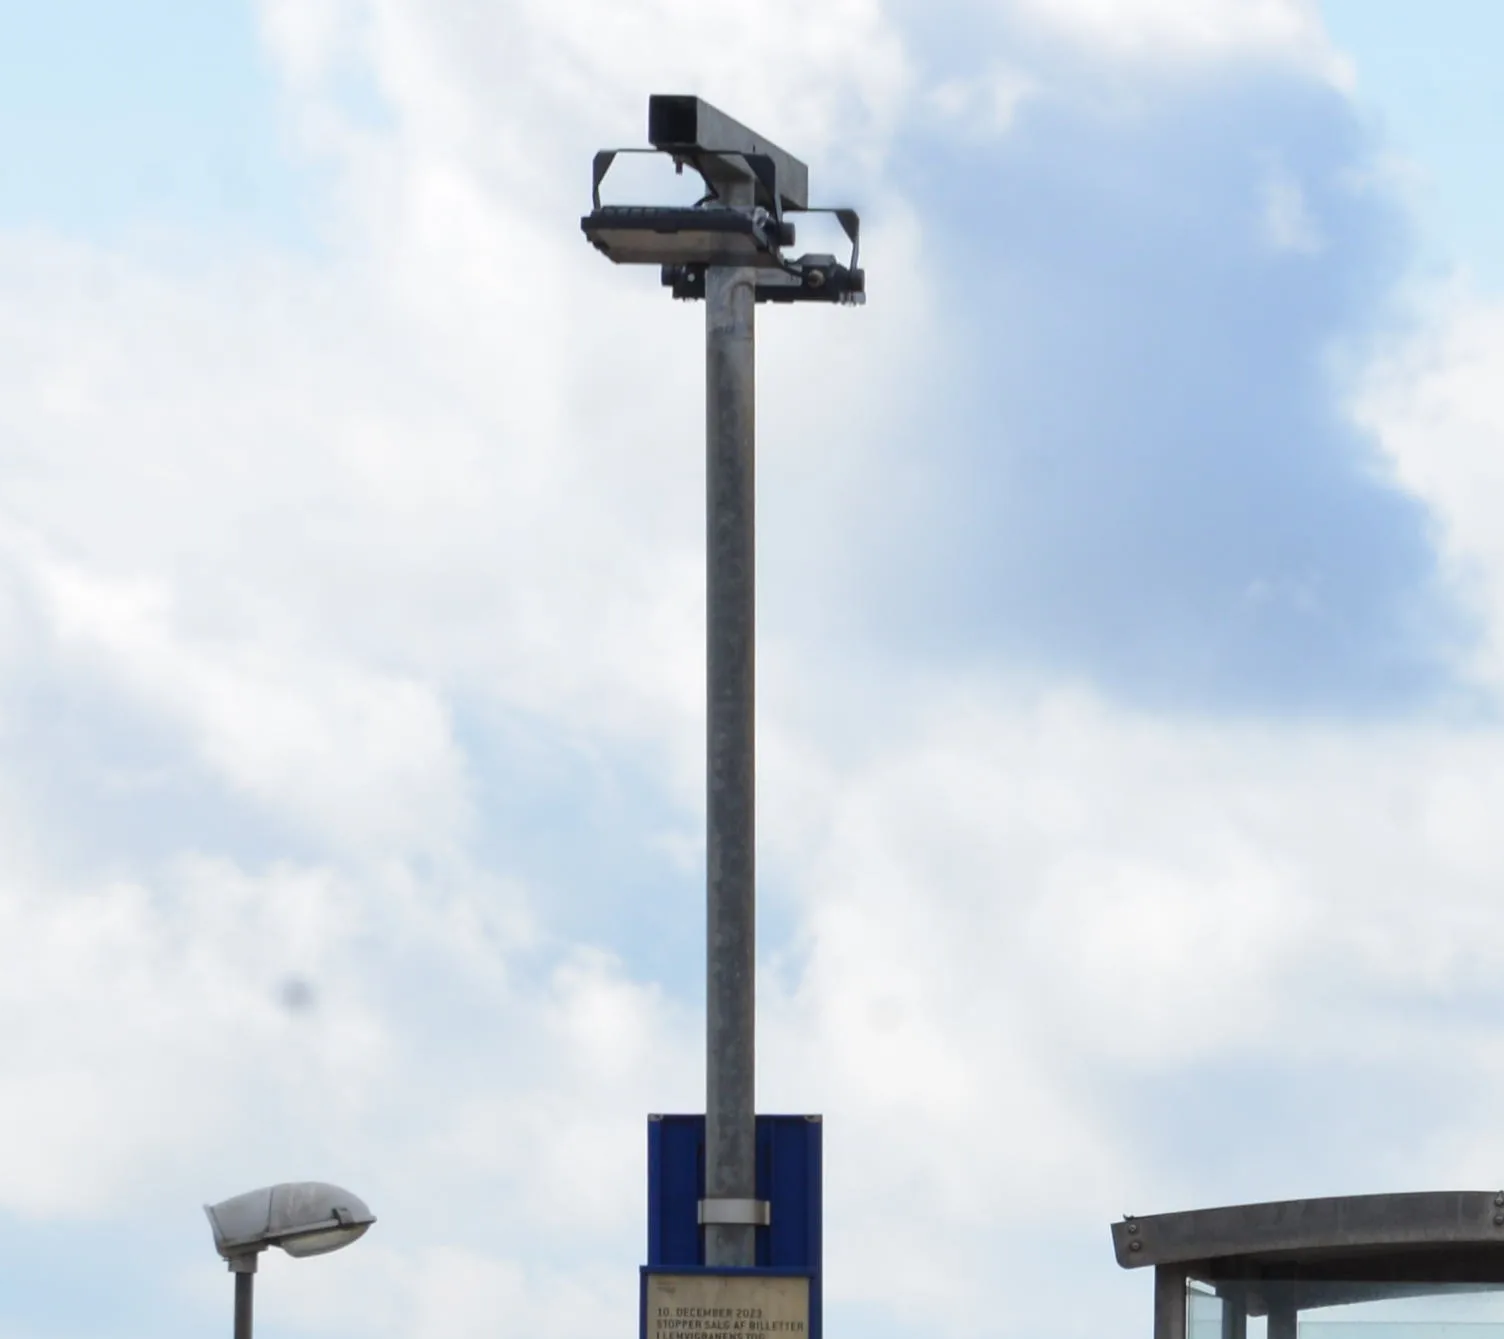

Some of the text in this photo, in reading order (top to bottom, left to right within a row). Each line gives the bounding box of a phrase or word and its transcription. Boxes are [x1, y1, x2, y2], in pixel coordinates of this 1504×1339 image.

[676, 1307, 733, 1319] DECEMBER
[656, 1319, 804, 1333] STOPPER SALG AF BILLETTER
